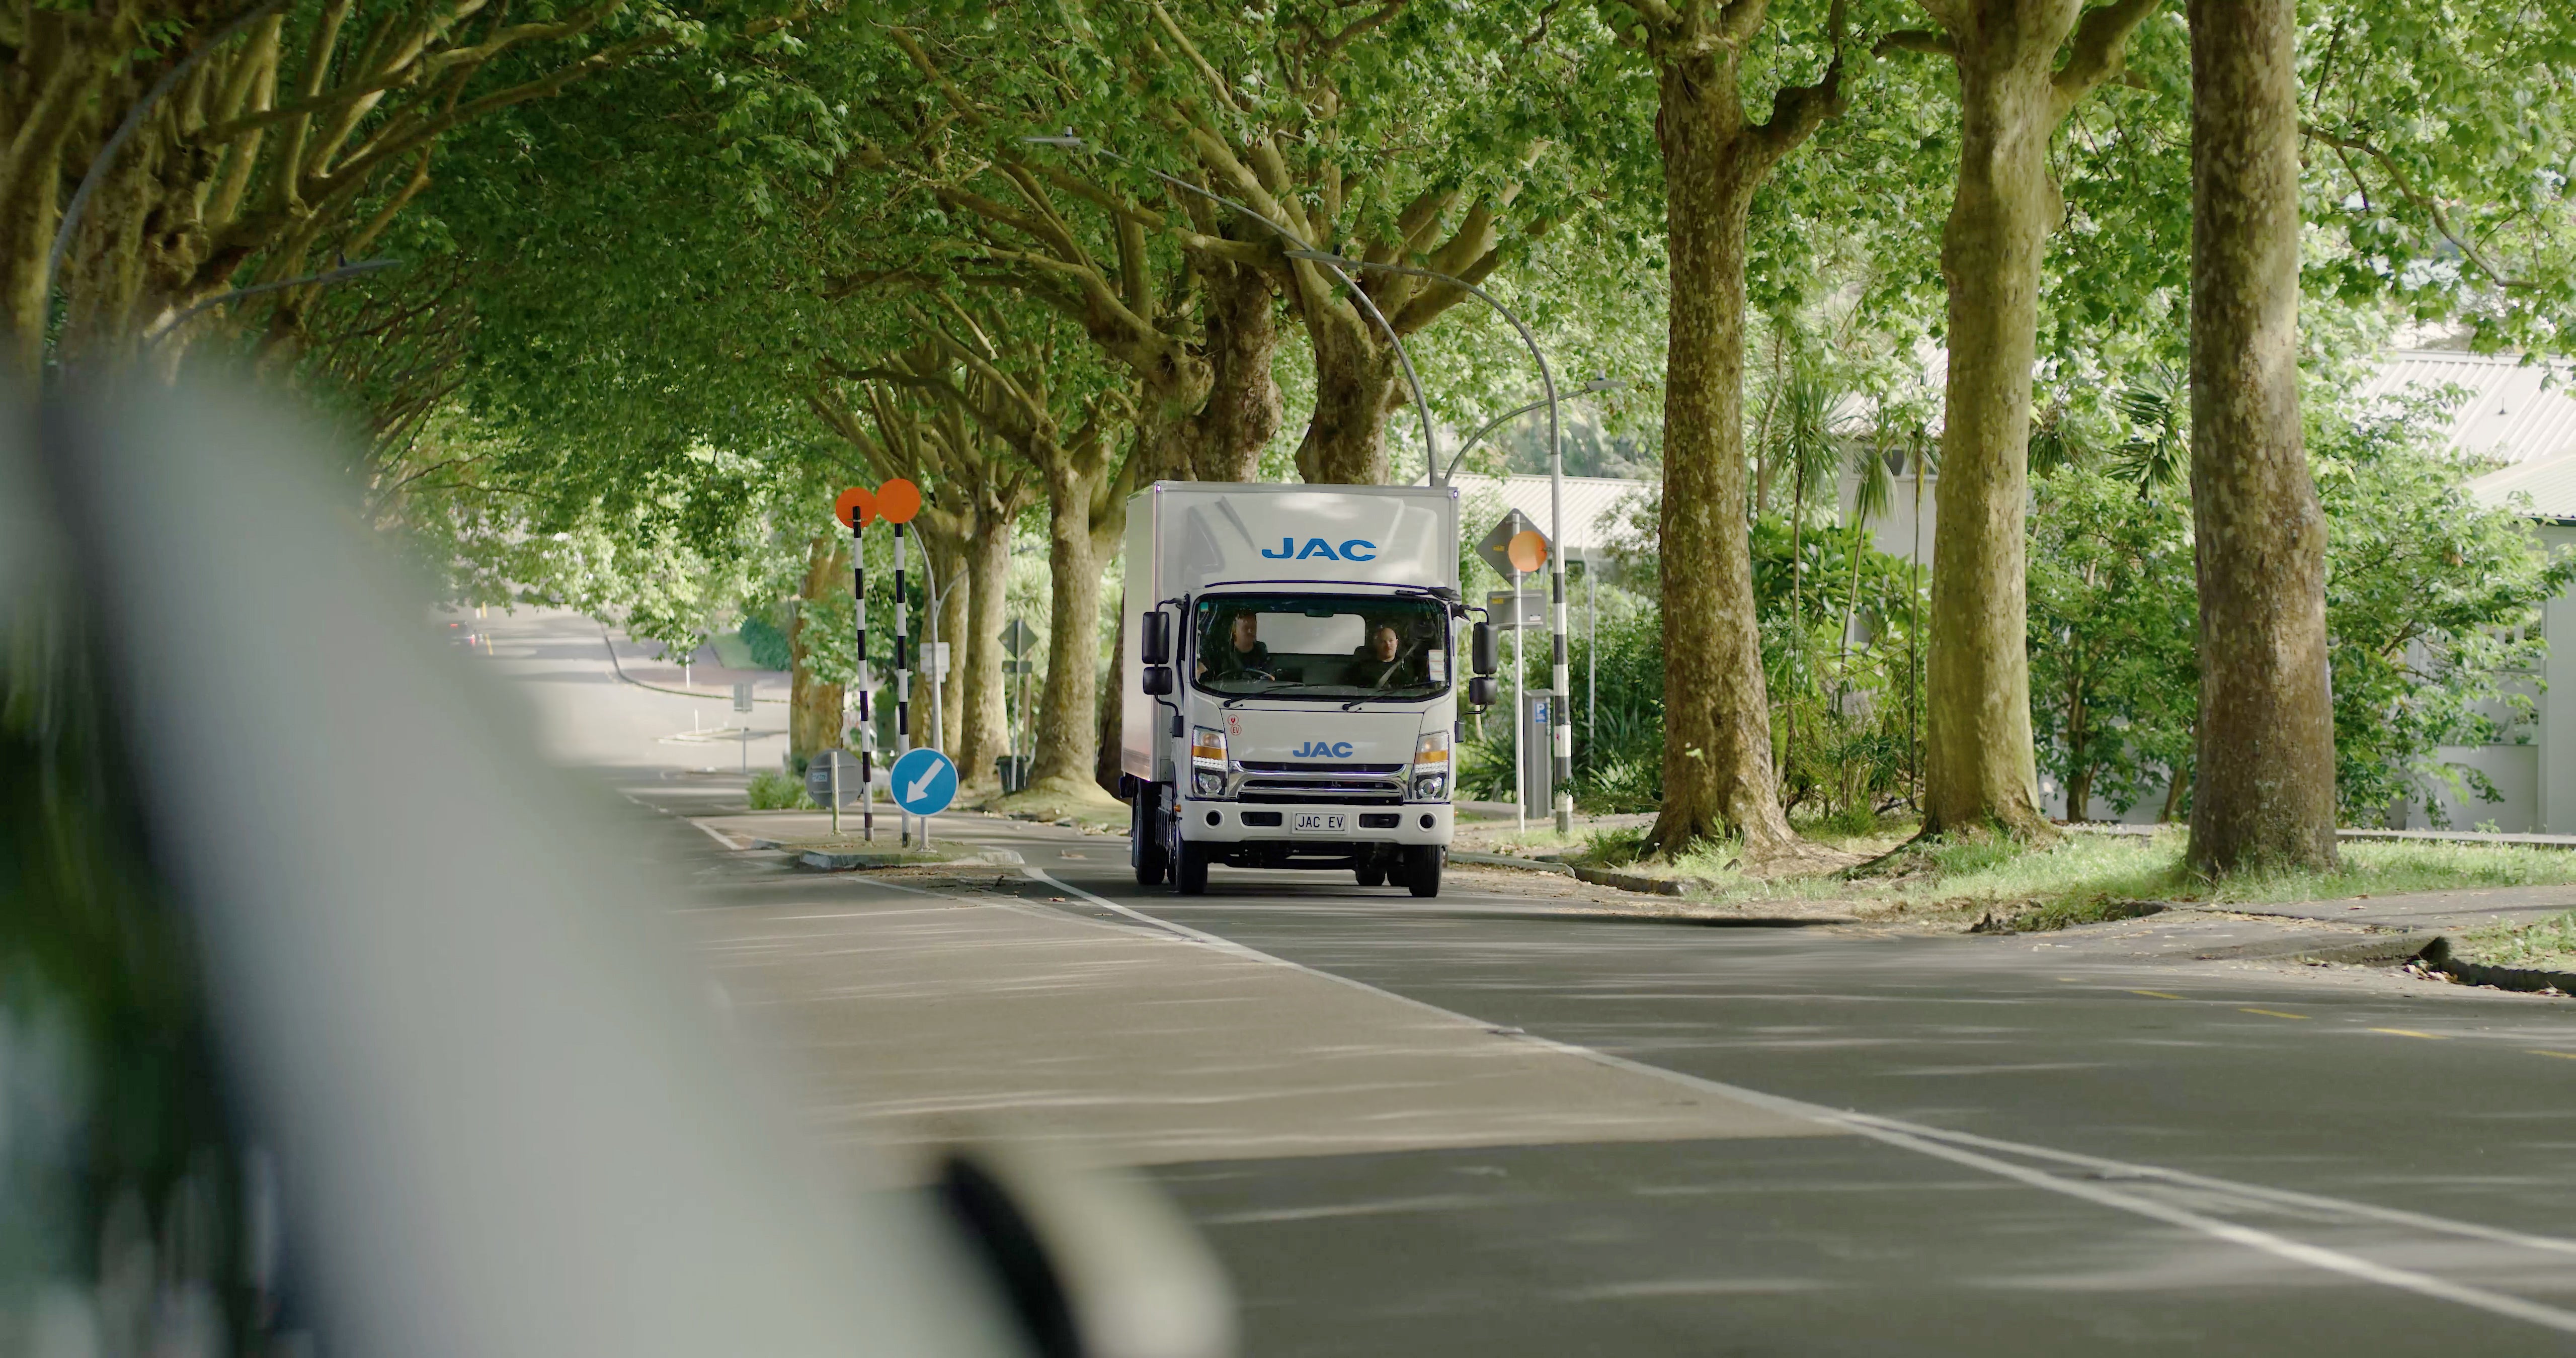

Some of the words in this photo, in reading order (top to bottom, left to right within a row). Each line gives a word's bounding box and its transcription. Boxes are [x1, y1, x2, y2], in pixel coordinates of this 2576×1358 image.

[1262, 538, 1376, 561] JAC
[1537, 704, 1545, 713] P
[1293, 742, 1353, 758] JAC
[1299, 816, 1320, 827] JAC
[1329, 817, 1343, 828] EV
